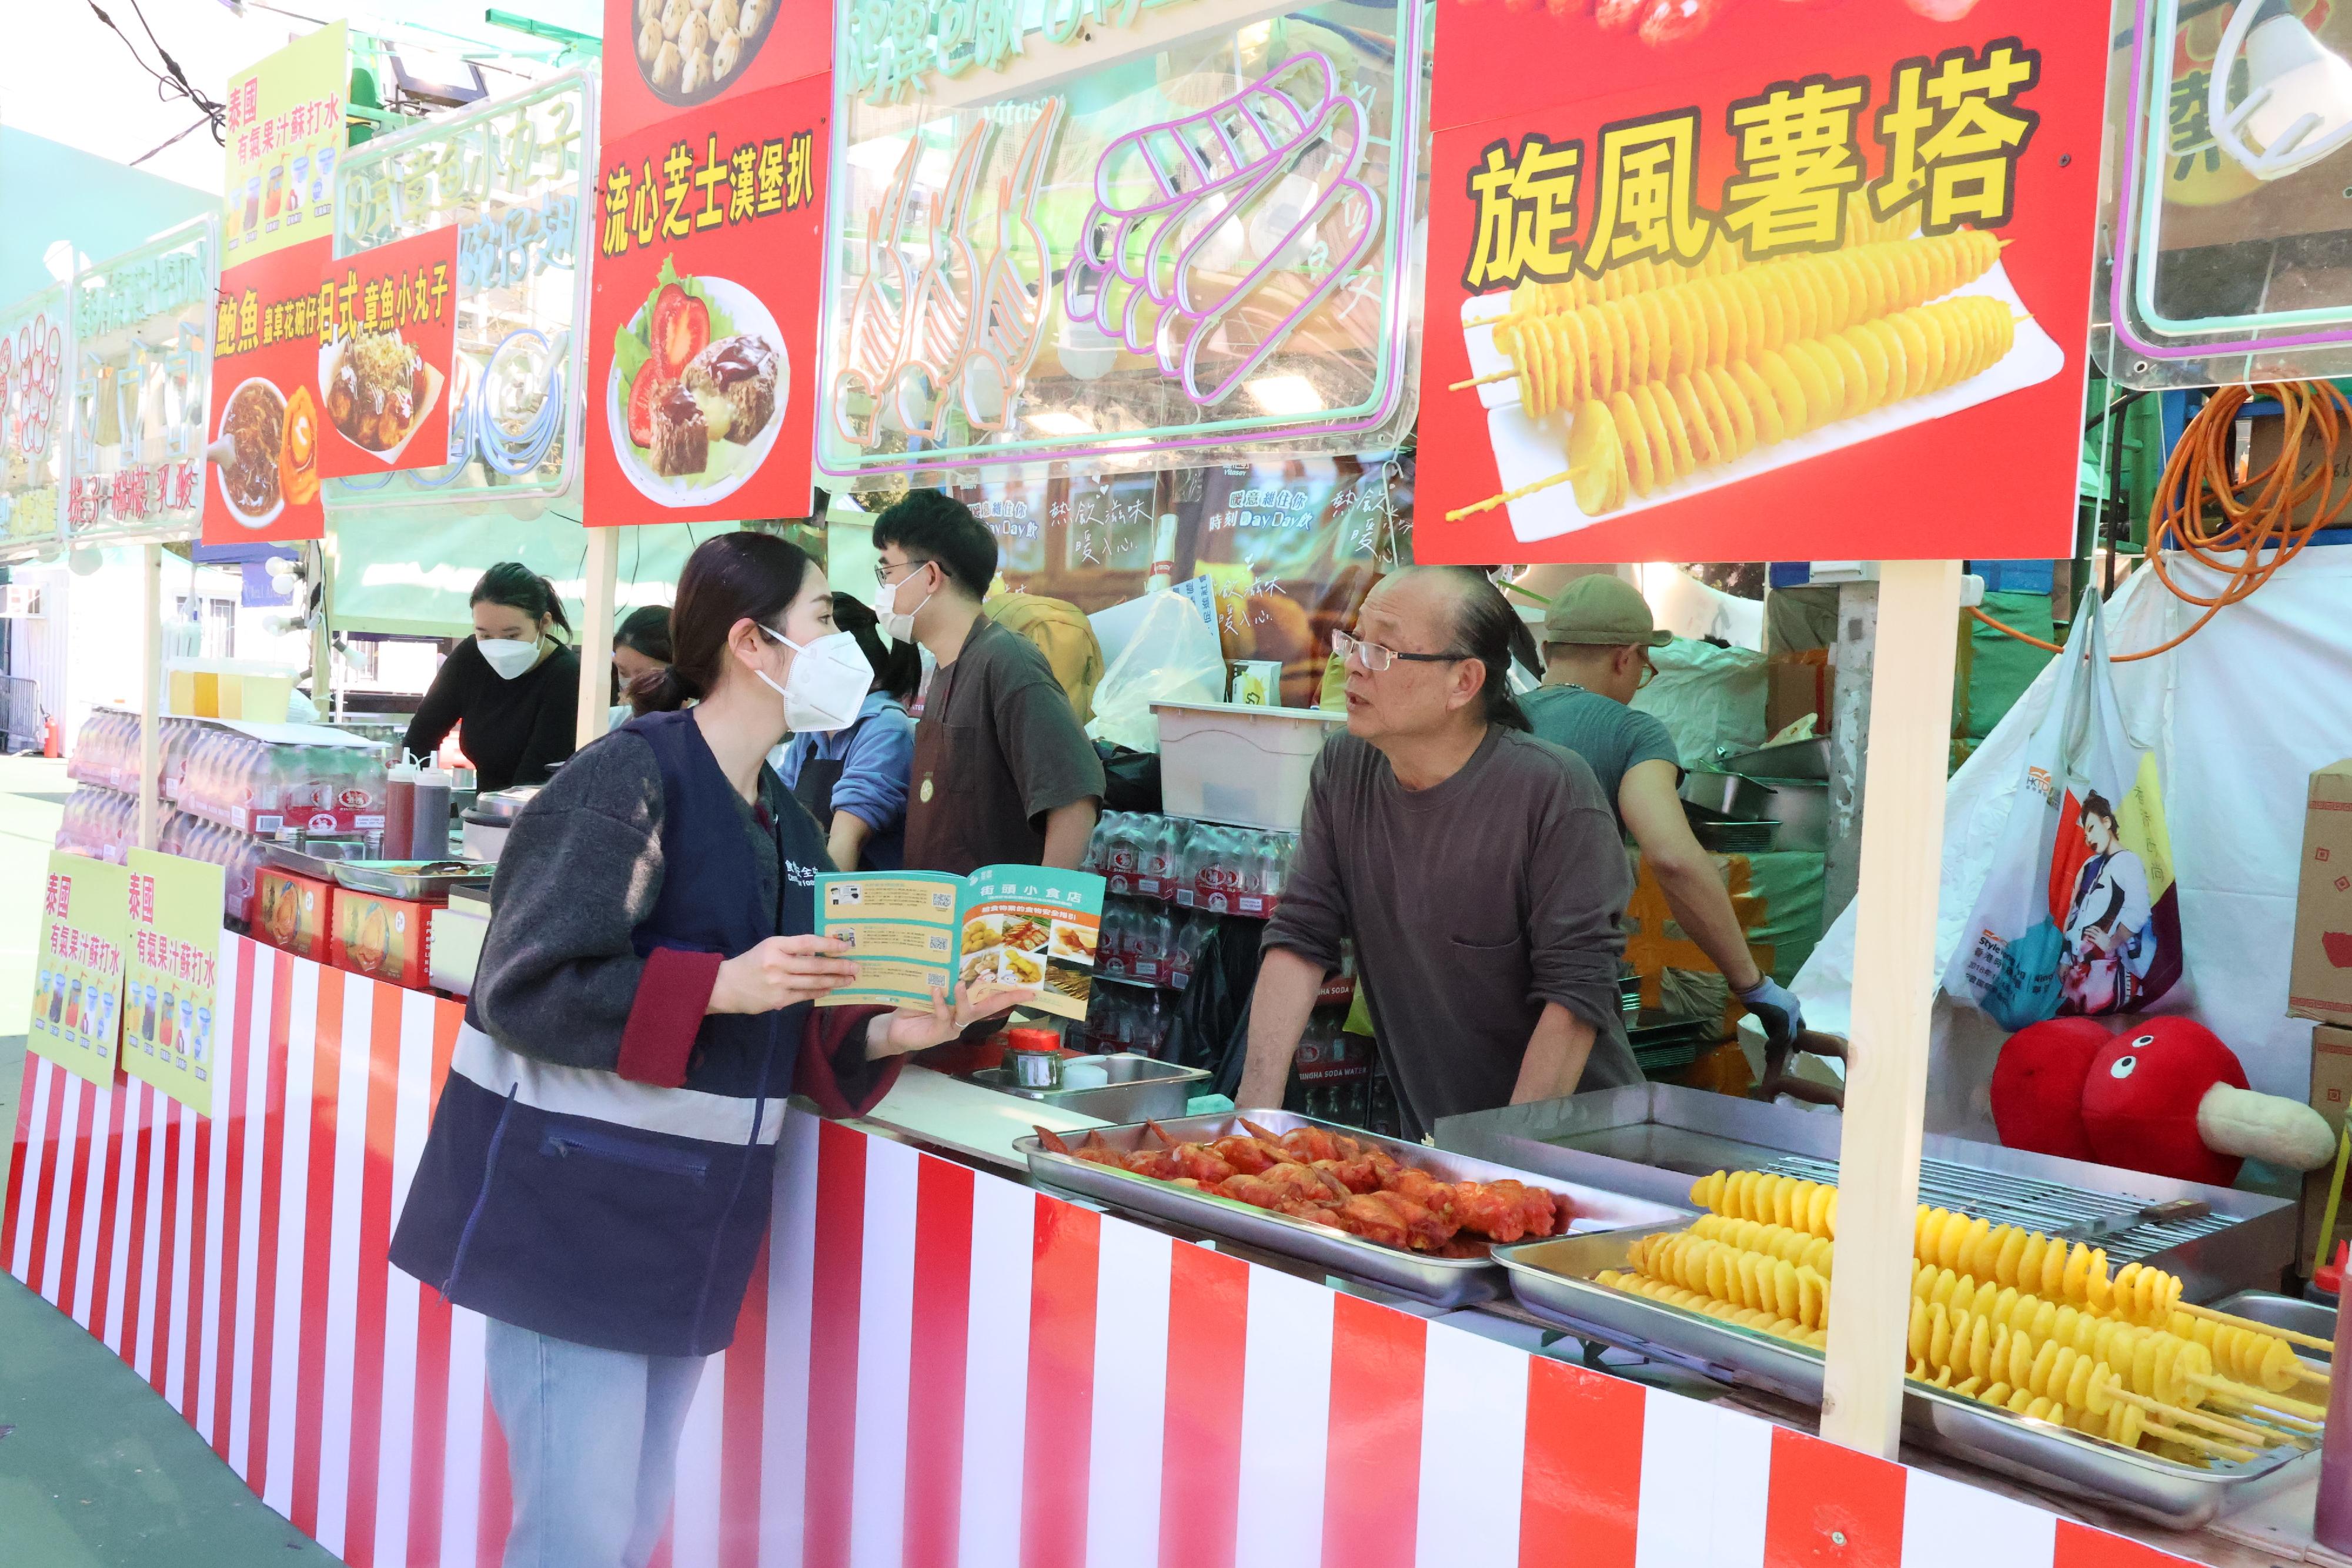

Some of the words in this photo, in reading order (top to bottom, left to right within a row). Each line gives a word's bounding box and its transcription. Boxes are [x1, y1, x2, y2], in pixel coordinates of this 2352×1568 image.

[228, 76, 258, 133] 泰國
[237, 92, 339, 166] 有氣果汁蘇打水
[1464, 39, 2039, 289] 旋風薯塔
[602, 131, 814, 256] 流心芝士漢堡扒
[1229, 489, 1308, 510] 暖意維住你
[46, 872, 72, 920] 泰國
[128, 872, 155, 925] 泰國
[981, 884, 1082, 904] 街頭小食店
[50, 922, 120, 977] 有氣果汁蘇打水
[137, 928, 215, 990] 有氣果汁蘇打水
[1324, 1069, 1343, 1078] SODA
